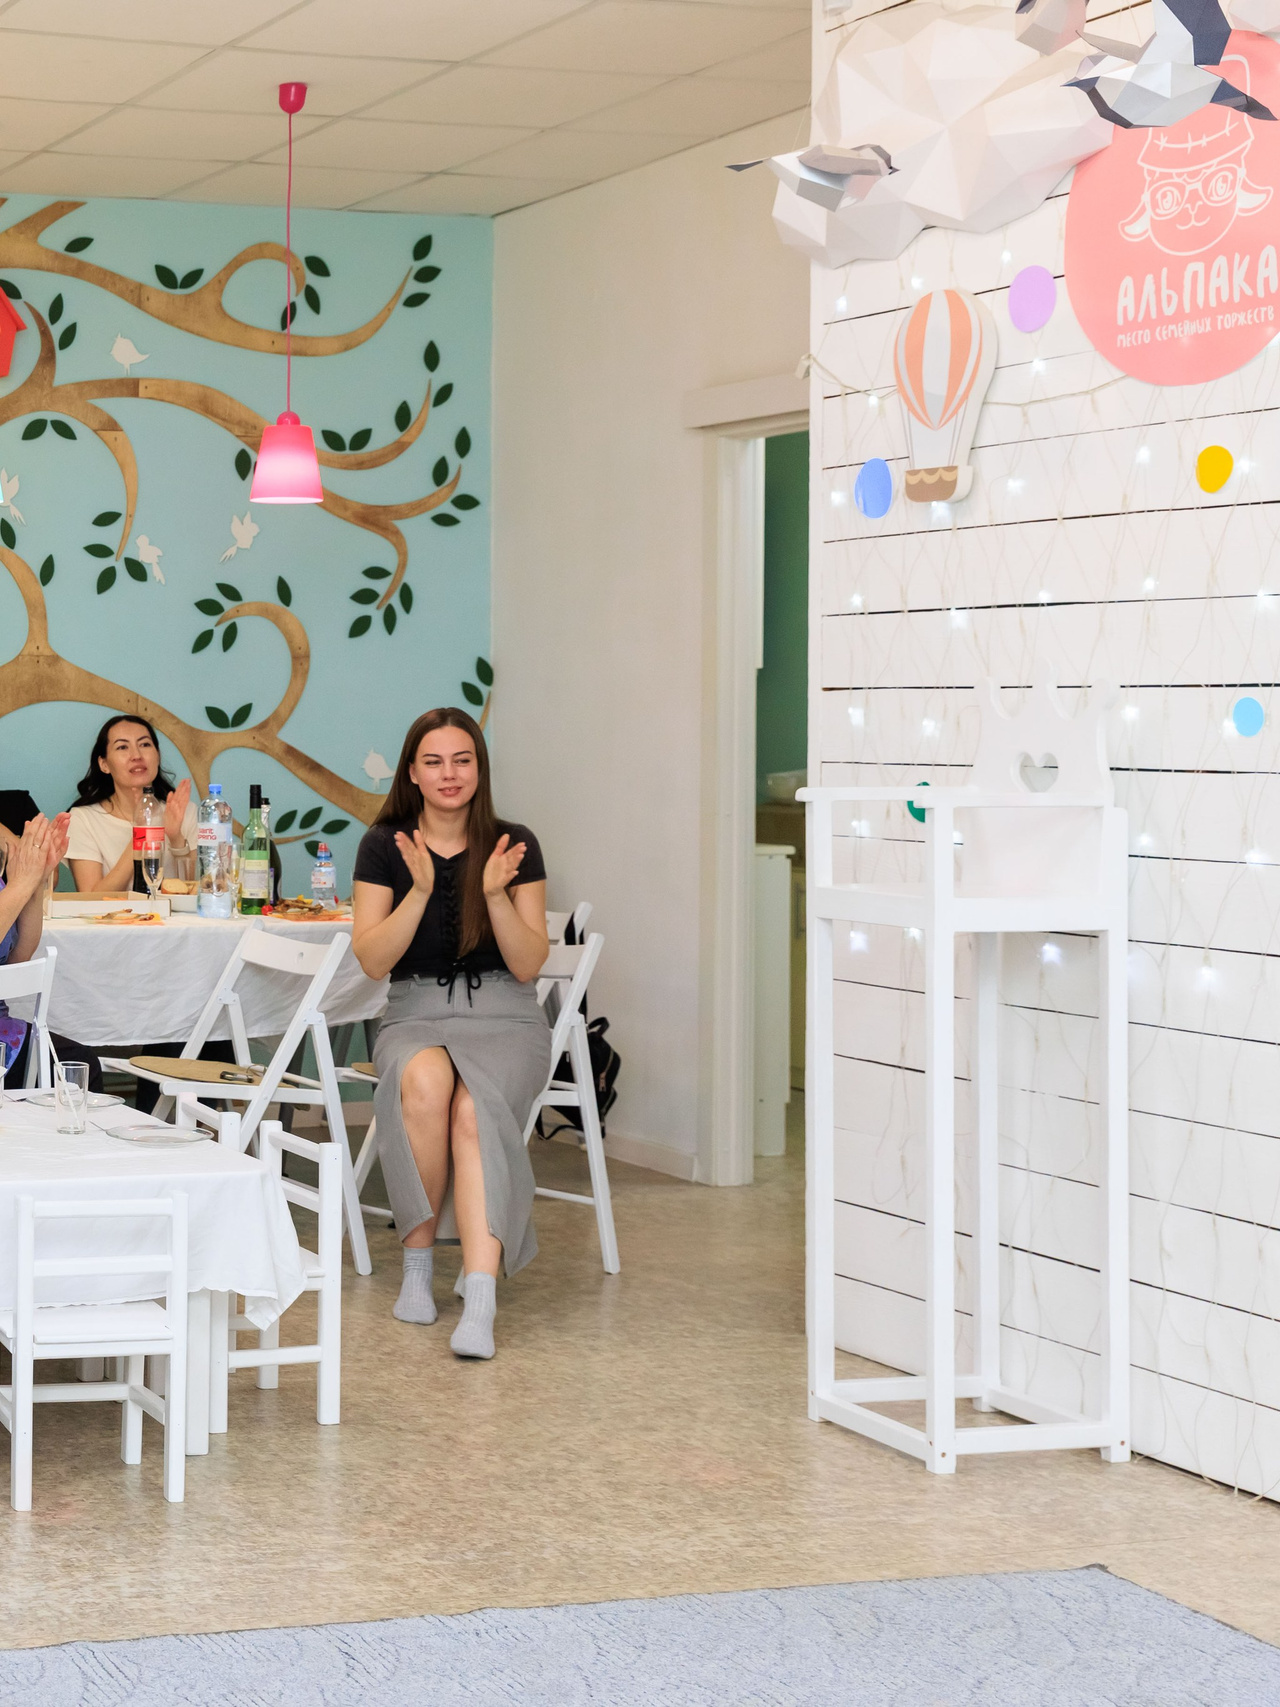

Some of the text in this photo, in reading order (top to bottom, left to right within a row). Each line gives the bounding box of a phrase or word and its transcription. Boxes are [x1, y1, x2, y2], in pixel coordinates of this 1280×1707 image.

[1116, 244, 1279, 326] АЛЬПАКА
[1116, 305, 1275, 348] МЕСТО СЕМЕЙНЫХ ТОРЖЕСТВ
